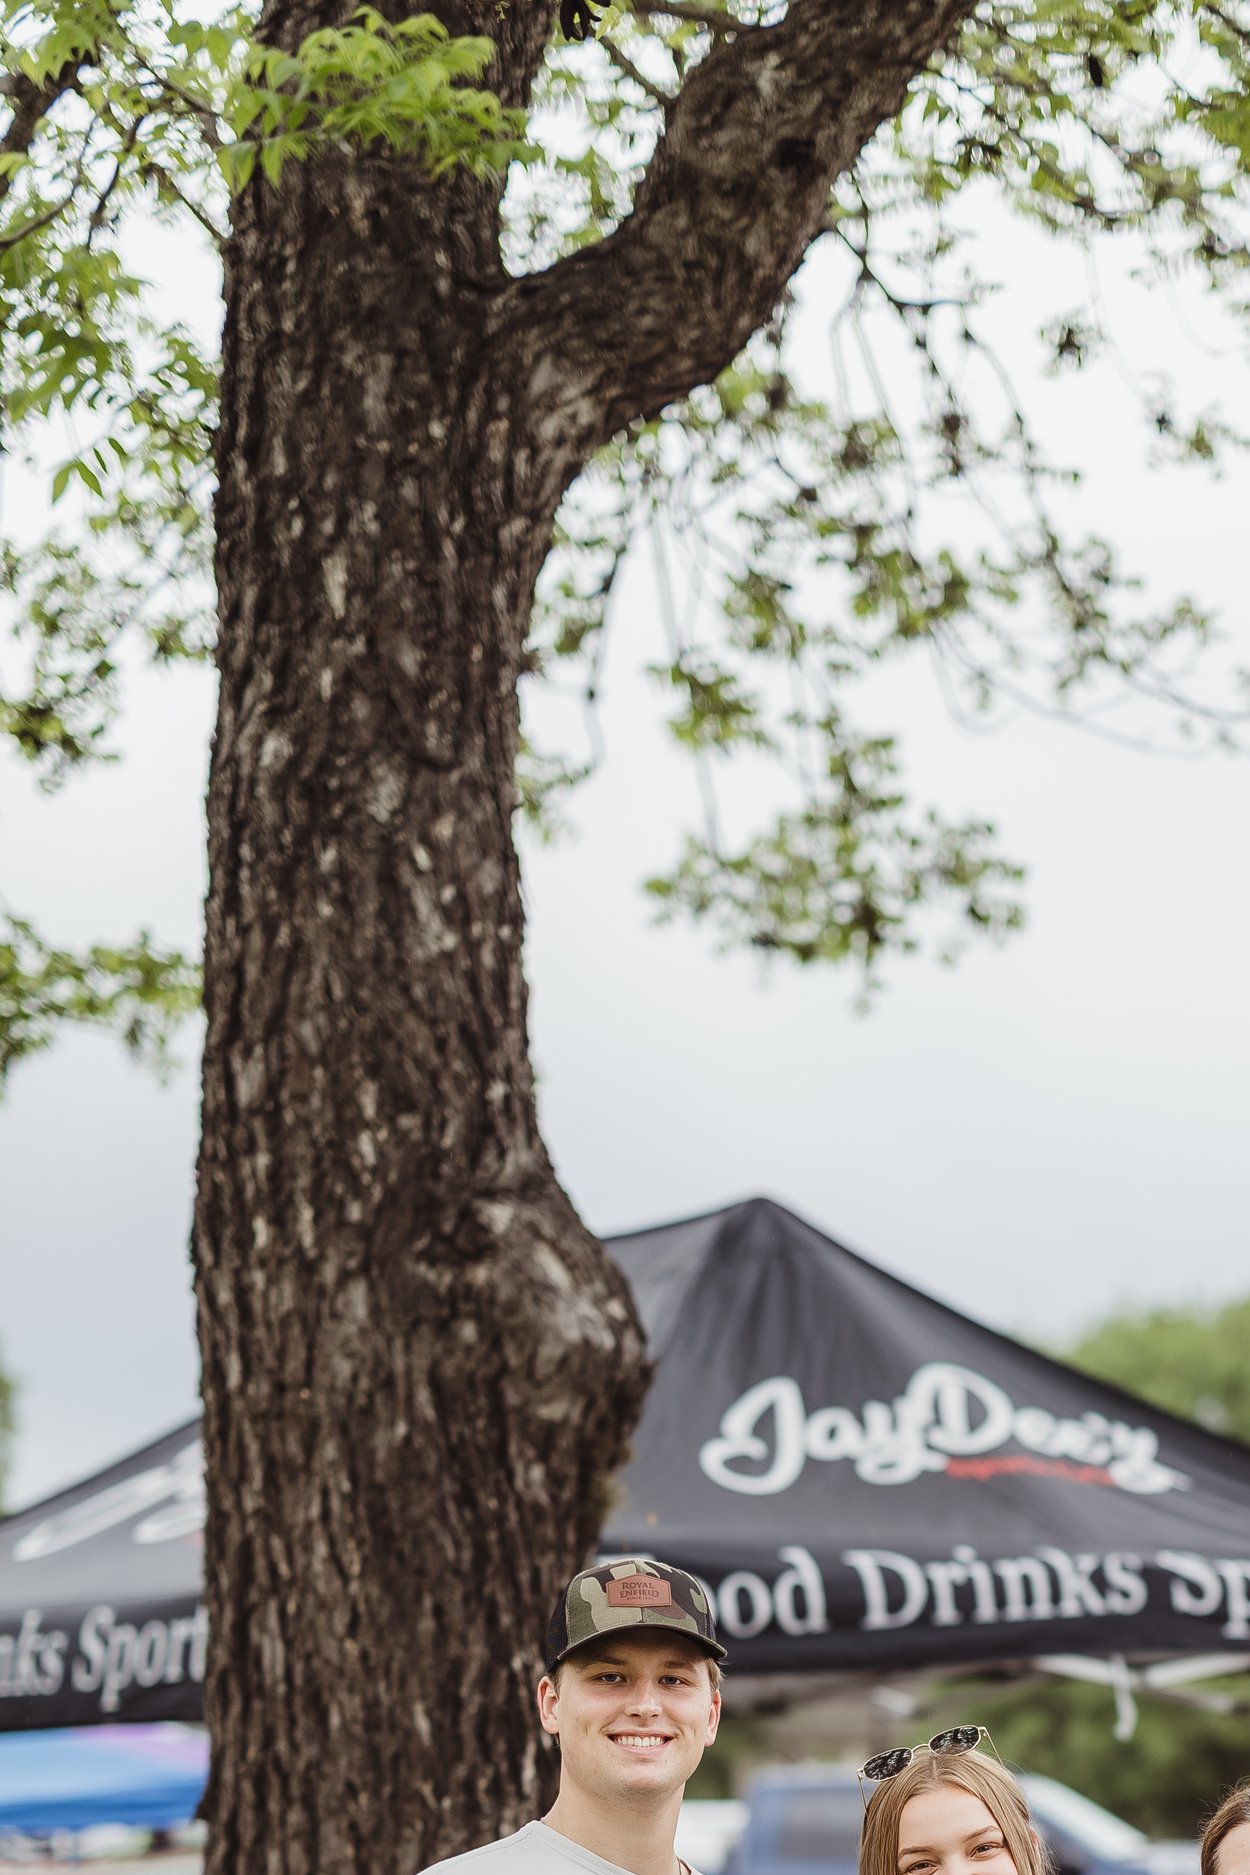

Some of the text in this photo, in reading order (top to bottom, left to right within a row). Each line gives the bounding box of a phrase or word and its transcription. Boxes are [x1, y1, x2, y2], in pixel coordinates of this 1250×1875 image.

[619, 1589, 660, 1598] ENFIELD
[842, 1545, 1150, 1632] Drinks
[71, 1604, 208, 1712] Sport
